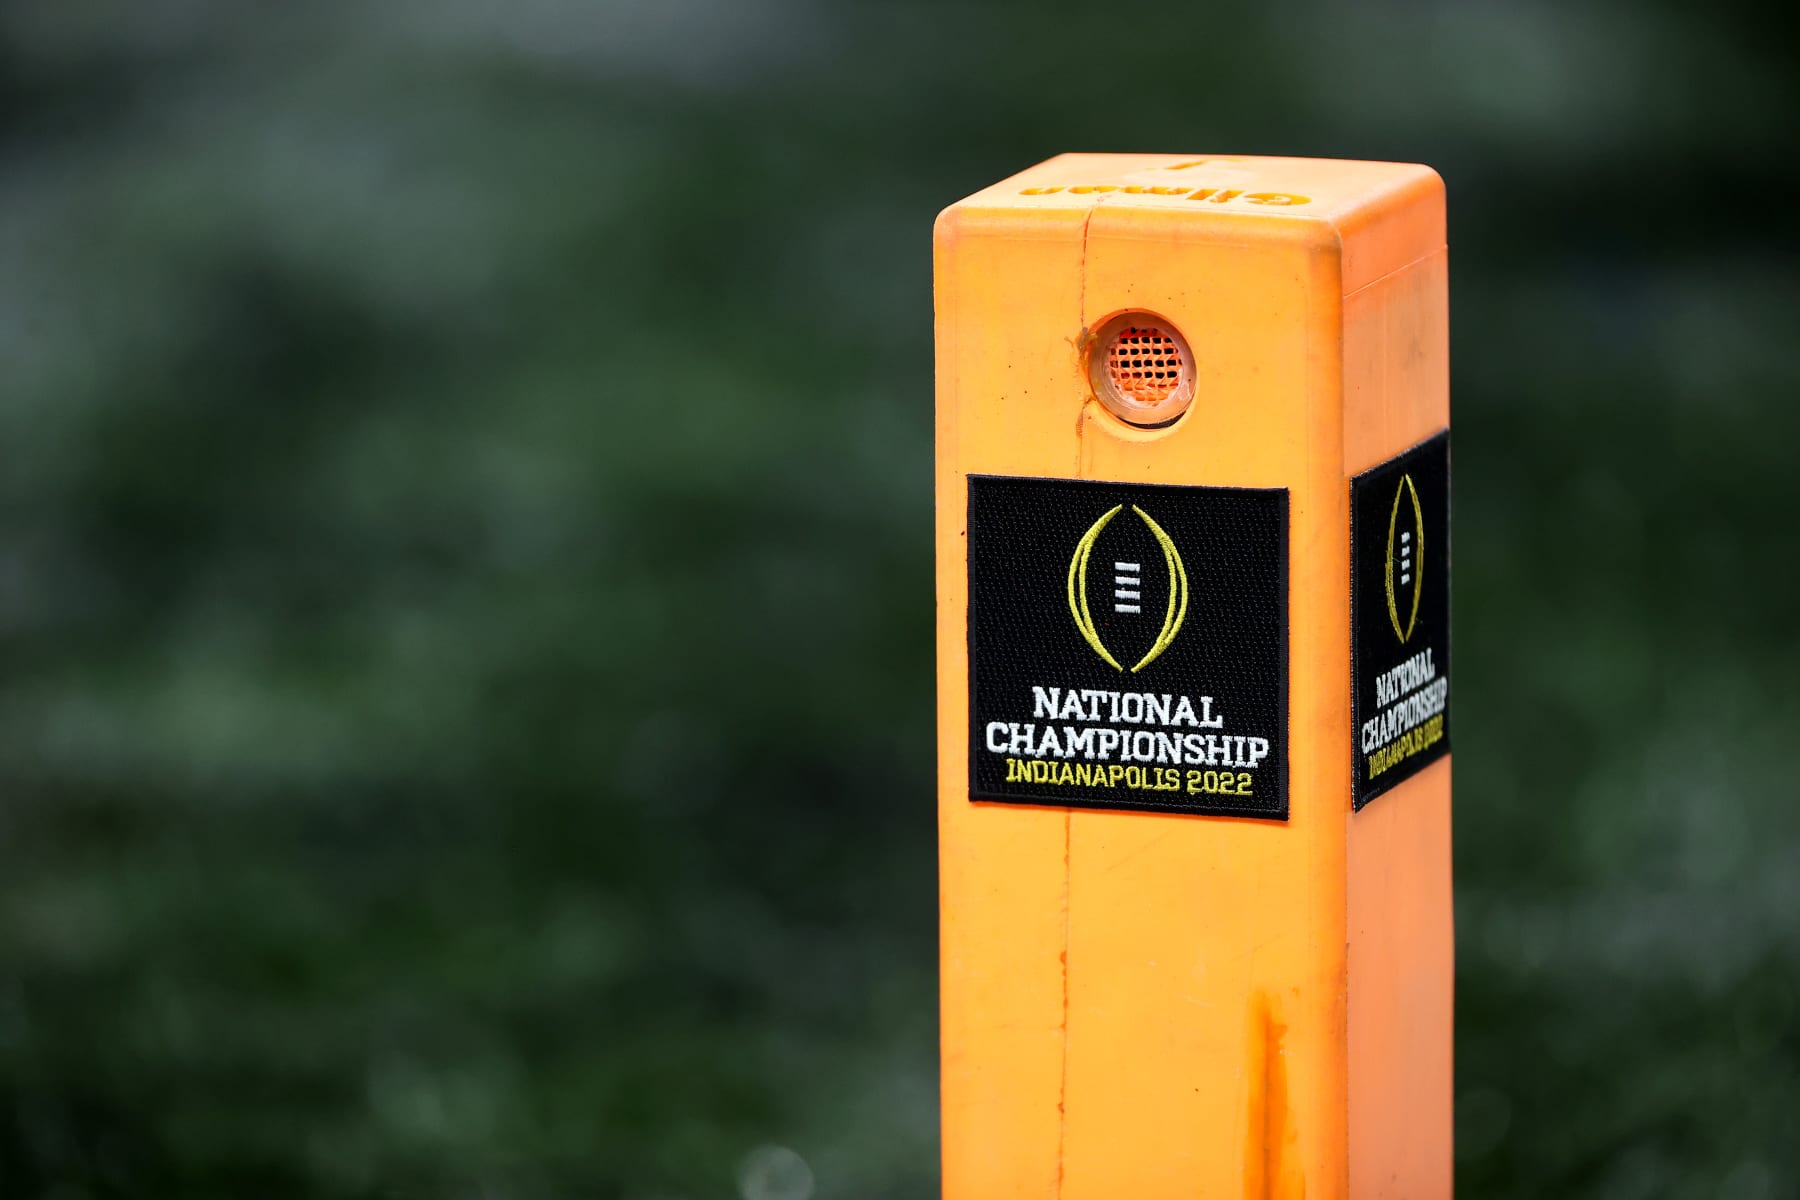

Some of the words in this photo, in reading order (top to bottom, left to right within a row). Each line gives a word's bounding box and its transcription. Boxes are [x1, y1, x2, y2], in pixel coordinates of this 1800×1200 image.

[1376, 647, 1436, 709] NATIONAL
[1032, 686, 1223, 728] NATIONAL
[1361, 676, 1448, 755] CHAMPIONSHIP
[986, 722, 1269, 768] CHAMPIONSHIP
[1006, 758, 1180, 792] INDIANAPOLIS
[1186, 770, 1253, 795] 2022
